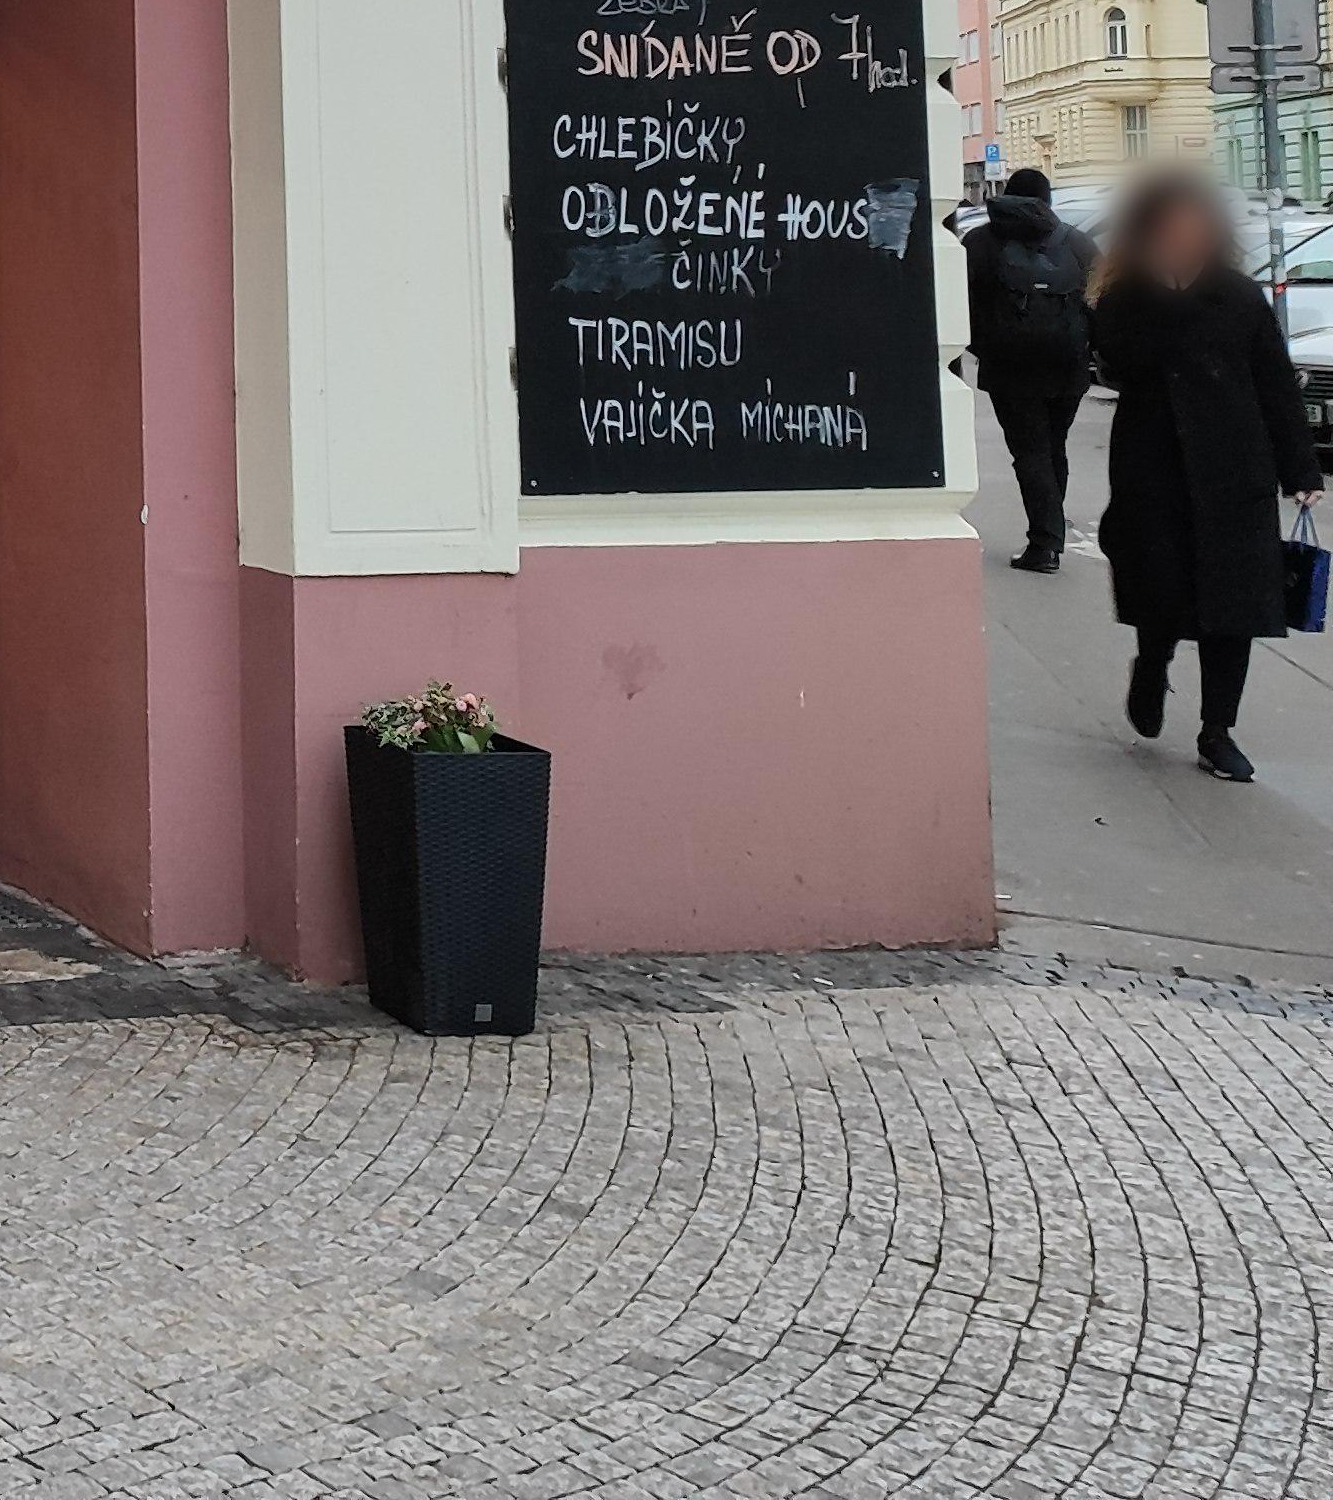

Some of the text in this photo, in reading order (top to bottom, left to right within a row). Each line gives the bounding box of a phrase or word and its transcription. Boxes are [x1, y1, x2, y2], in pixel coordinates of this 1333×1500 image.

[576, 7, 759, 80] SNÍDANĚ
[765, 29, 823, 76] OD
[553, 99, 747, 171] CHLEBÍČKY
[568, 316, 743, 370] TIRAMISU
[579, 370, 869, 452] VAJÍČKA MÍCHANÁ
